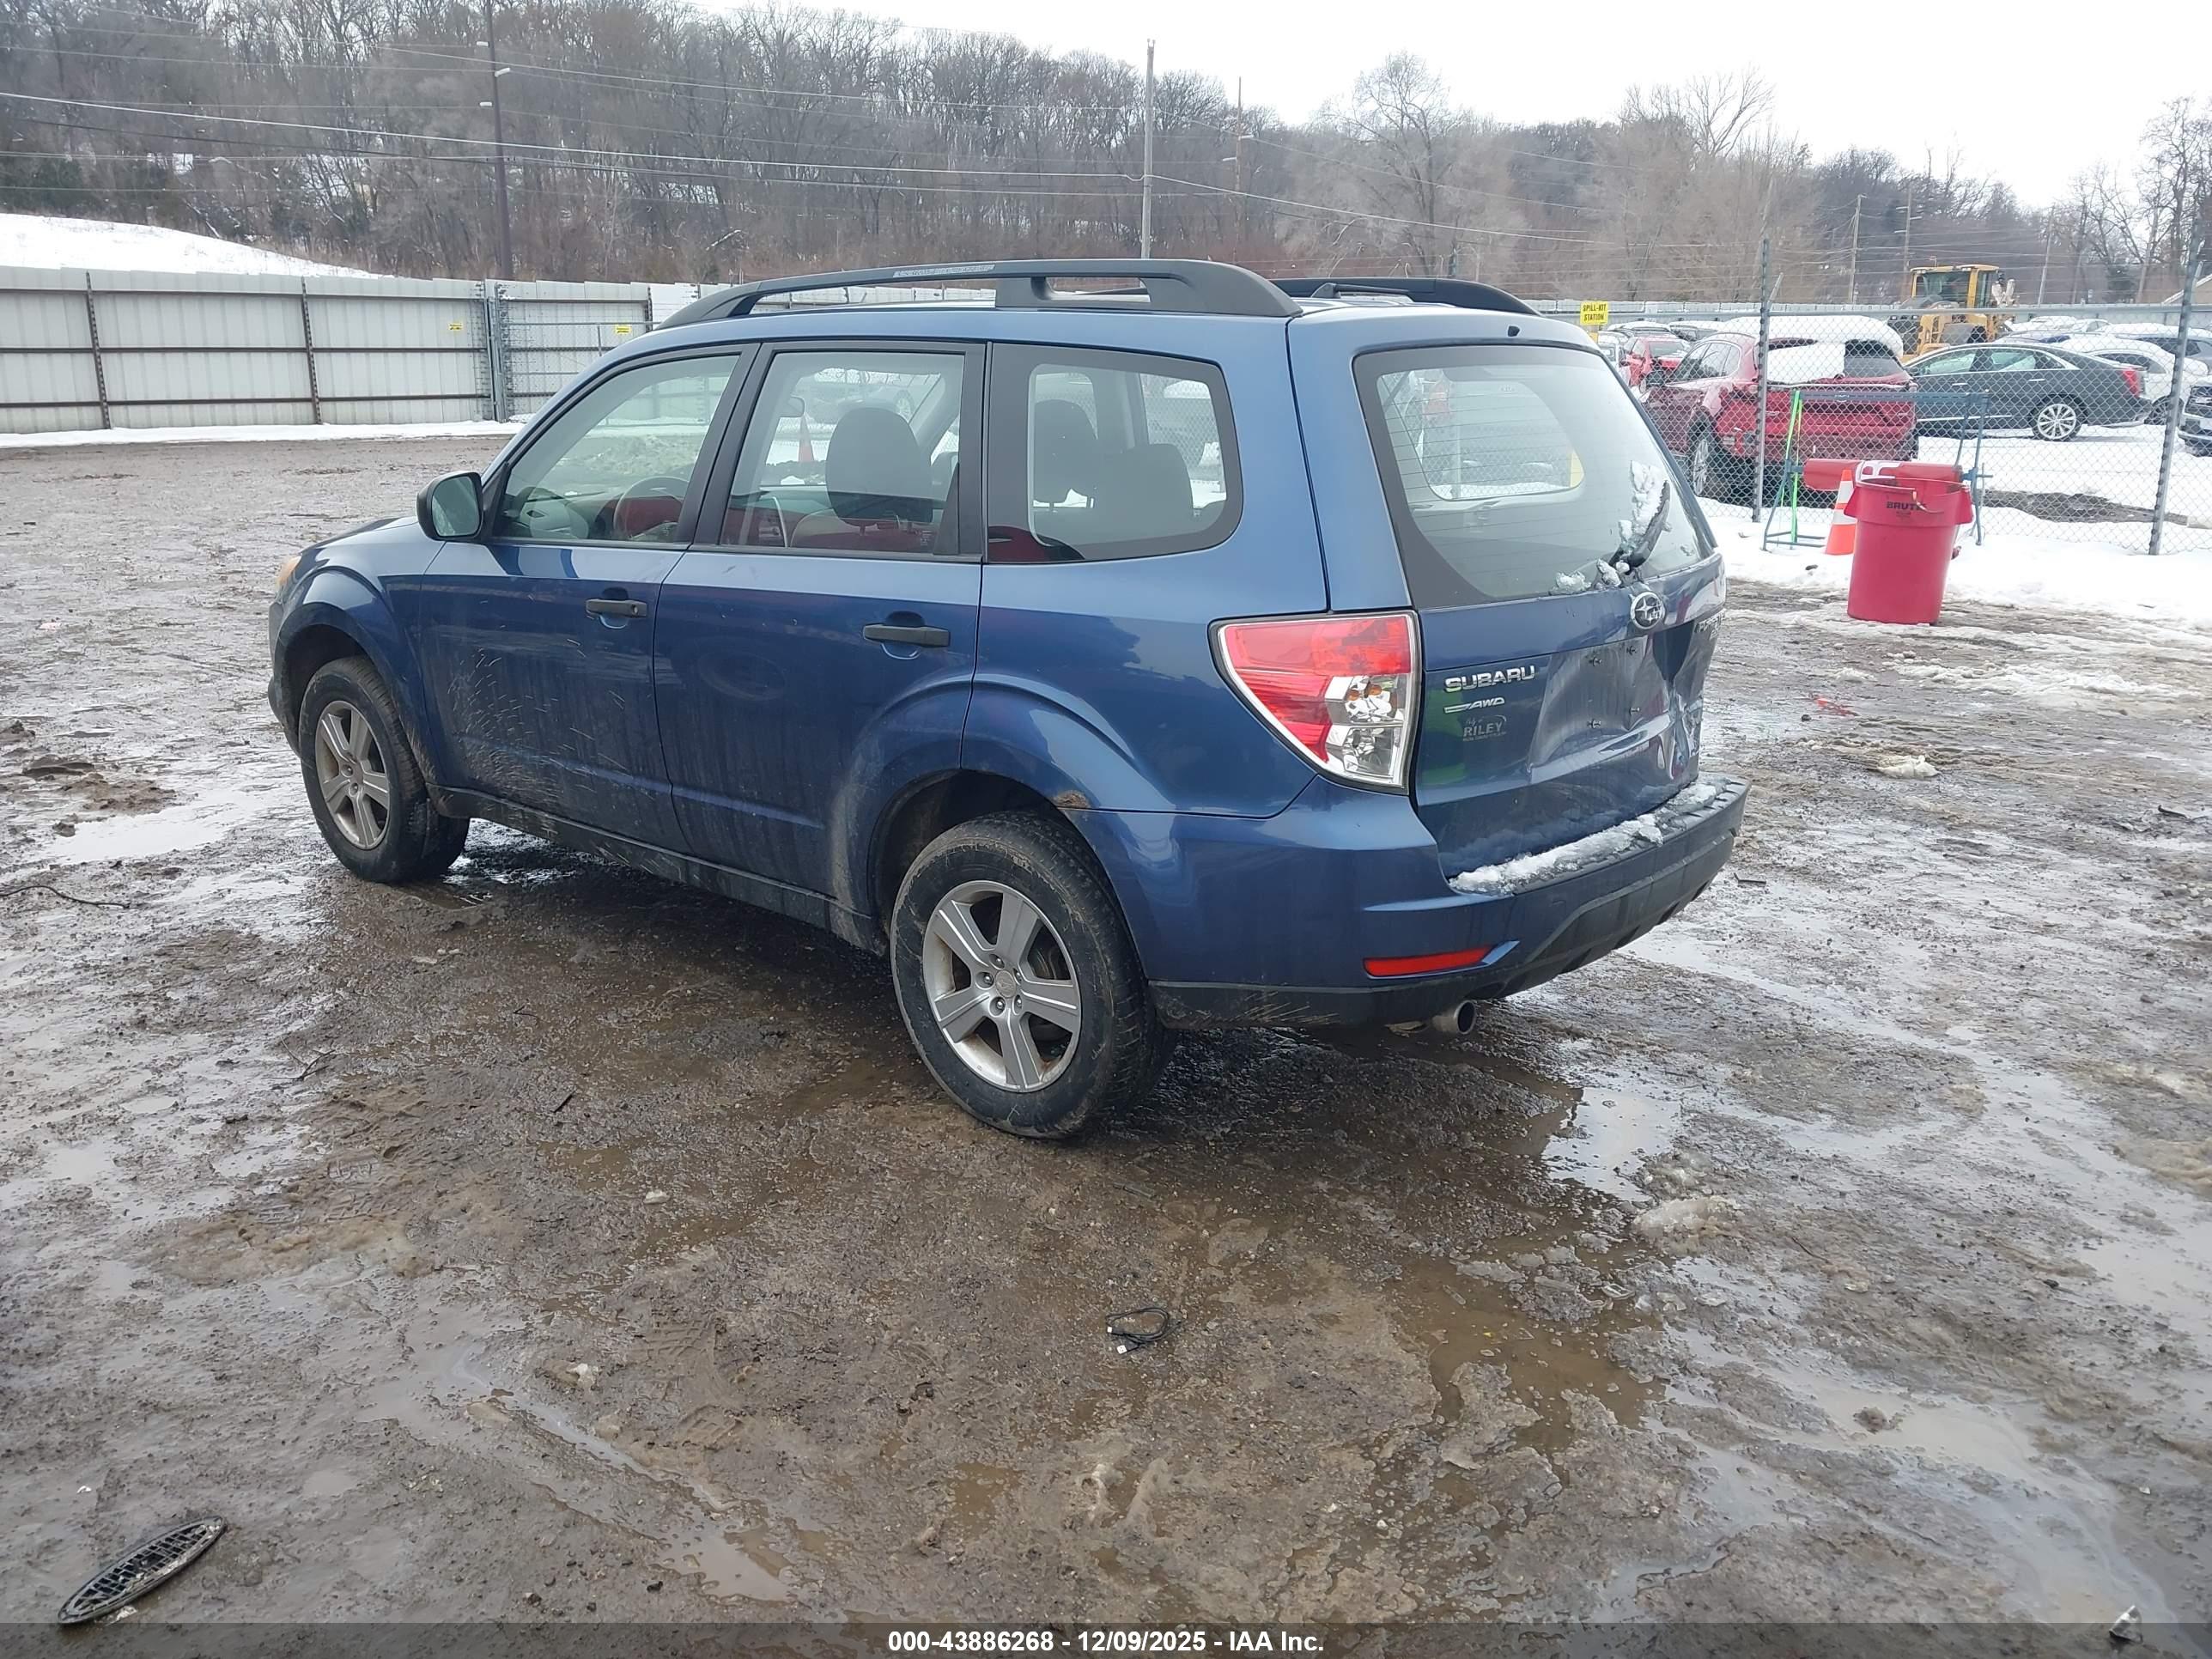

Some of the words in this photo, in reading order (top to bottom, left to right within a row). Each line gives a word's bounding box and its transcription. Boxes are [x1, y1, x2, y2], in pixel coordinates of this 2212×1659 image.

[1444, 665, 1535, 693] SUBARU
[1469, 696, 1505, 710] AWD
[1462, 721, 1503, 738] RILEY
